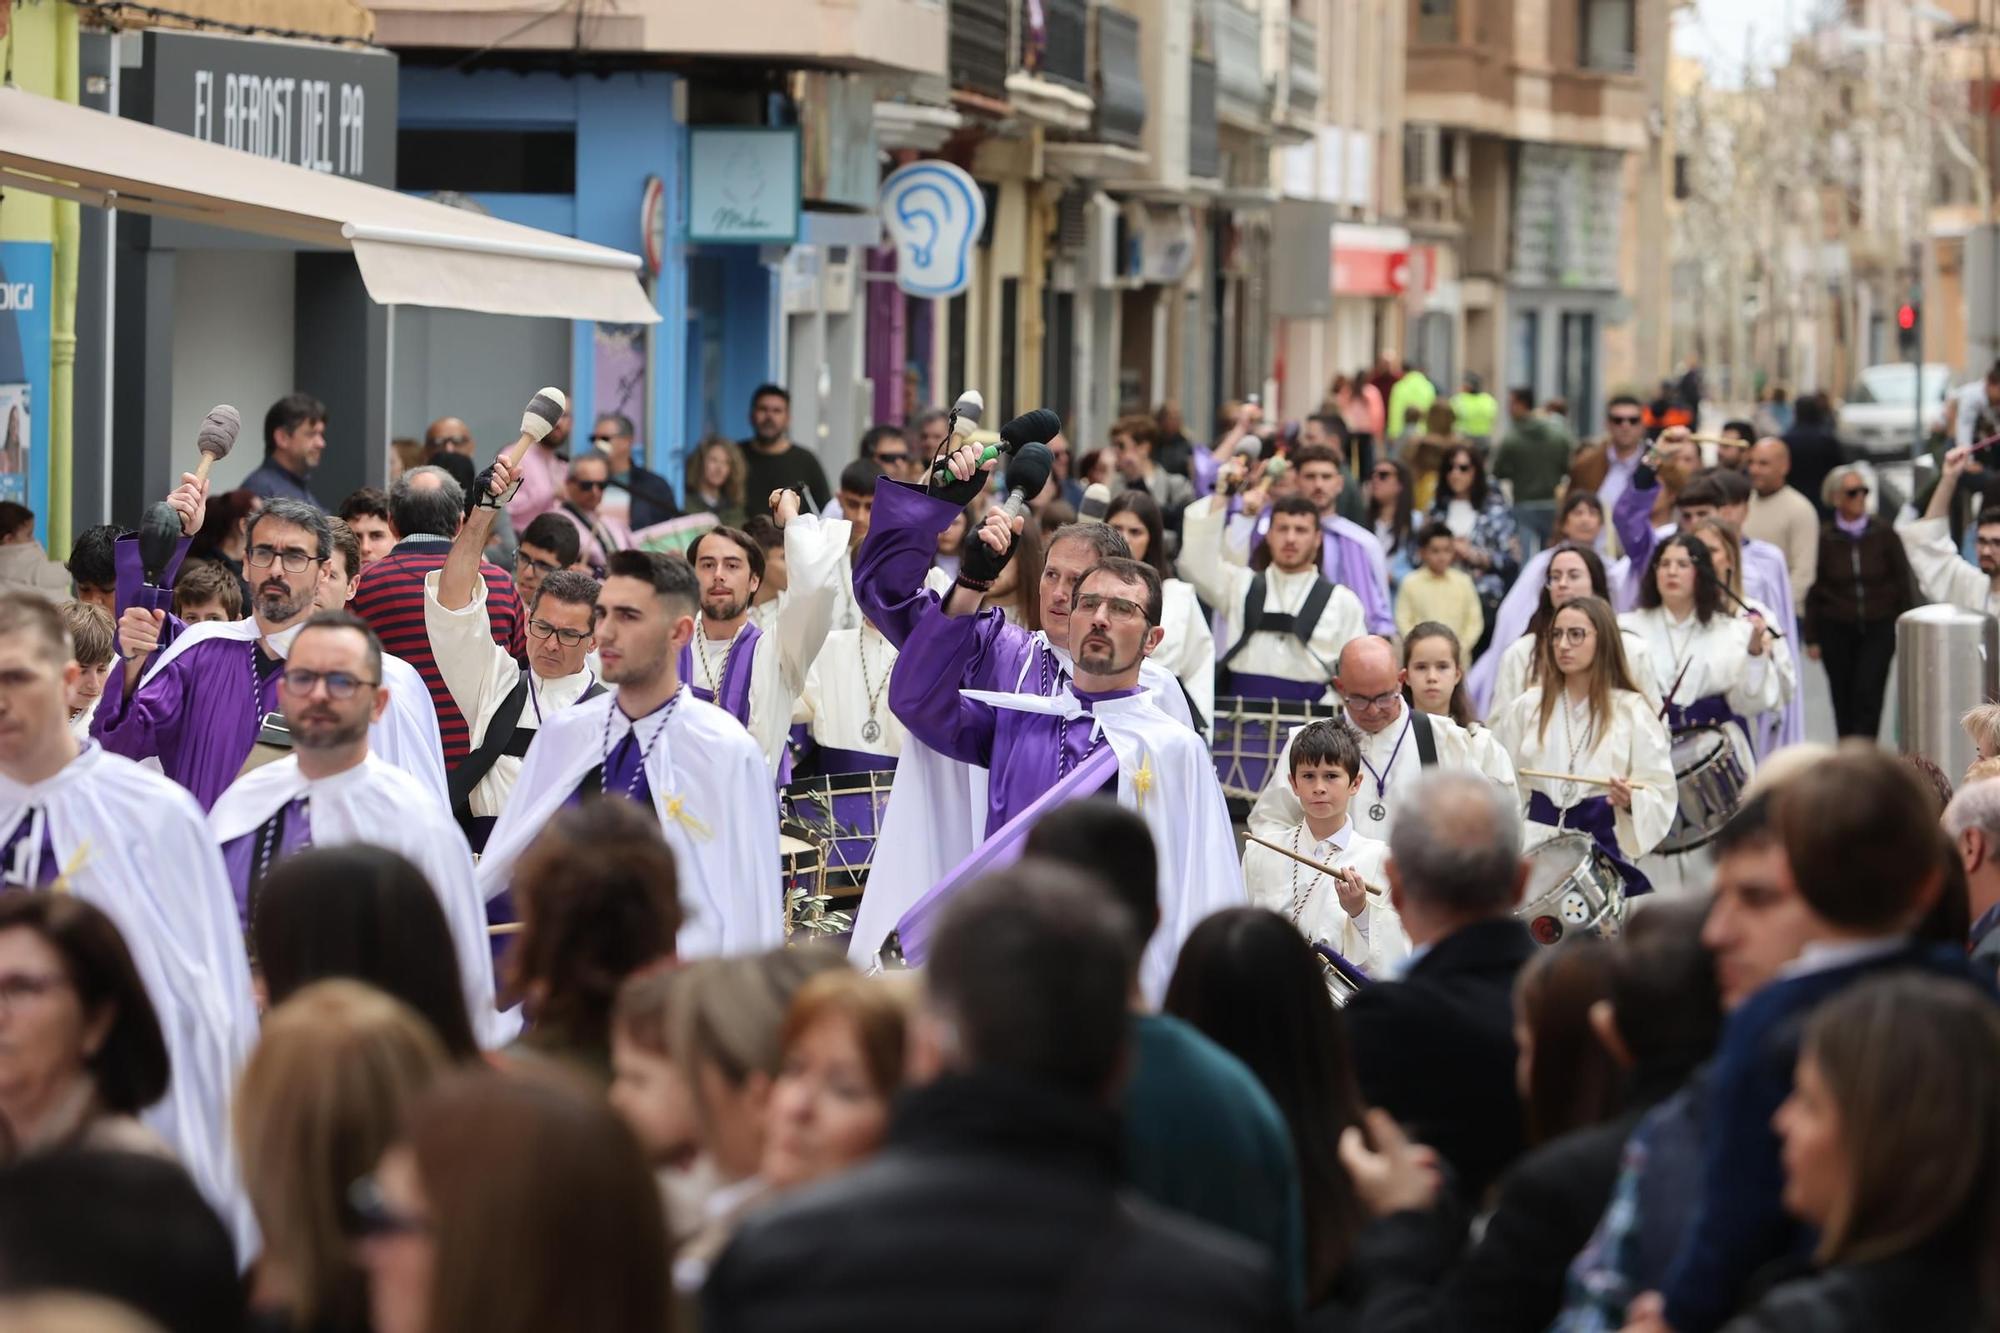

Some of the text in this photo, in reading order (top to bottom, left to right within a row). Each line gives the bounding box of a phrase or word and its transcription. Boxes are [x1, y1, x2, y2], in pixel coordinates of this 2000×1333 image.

[301, 79, 333, 173] DEL
[340, 83, 364, 175] PA
[0, 283, 34, 310] DIGI
